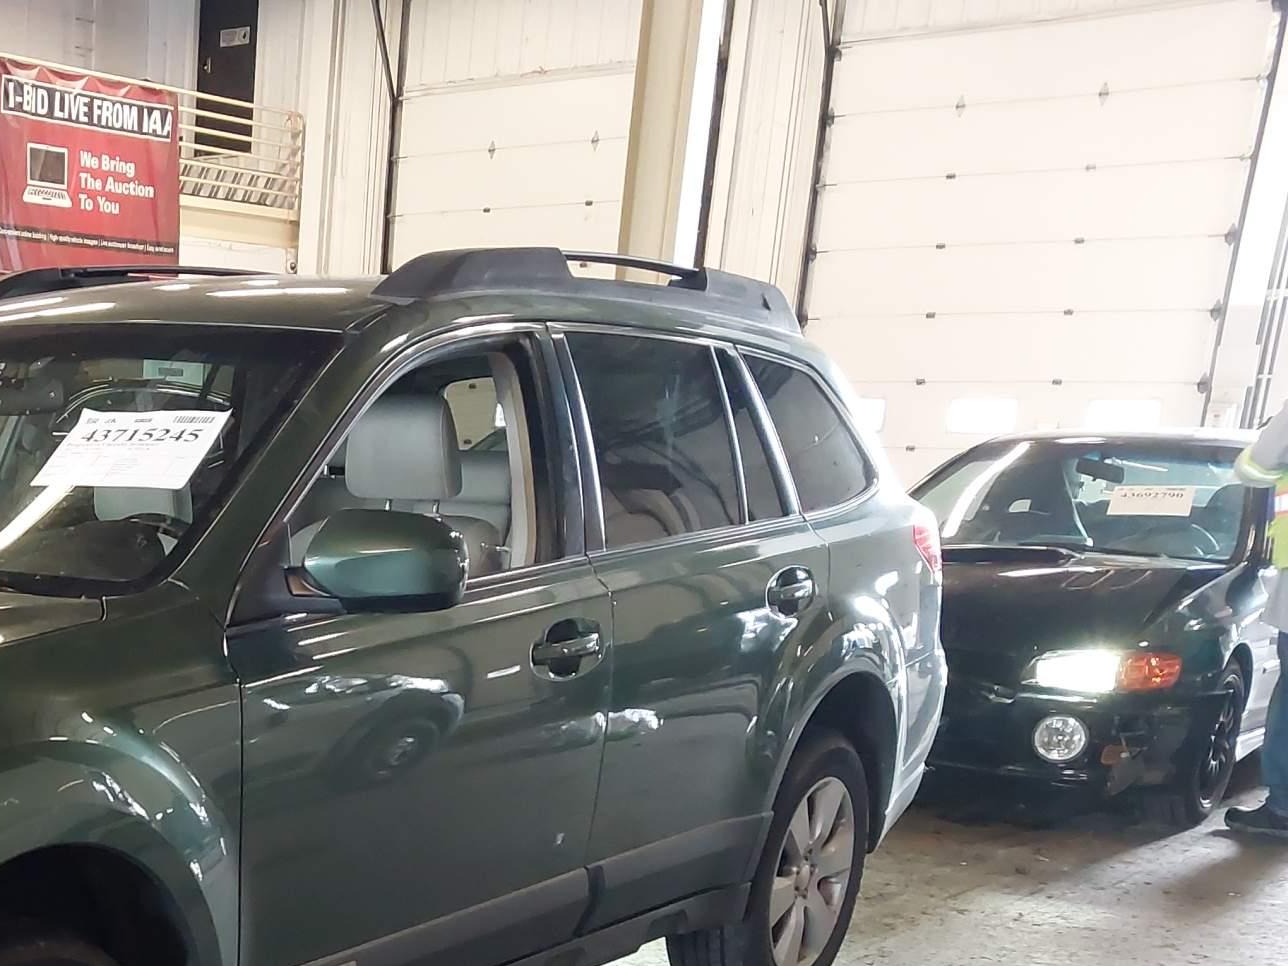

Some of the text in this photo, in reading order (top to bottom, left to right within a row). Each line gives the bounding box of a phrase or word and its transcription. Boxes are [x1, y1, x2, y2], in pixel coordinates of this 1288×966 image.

[54, 91, 89, 124] LIVE
[93, 100, 139, 133] FROM
[79, 150, 136, 177] We Bring
[79, 172, 155, 198] The Auction
[78, 194, 120, 215] To You
[81, 428, 205, 443] 43715245
